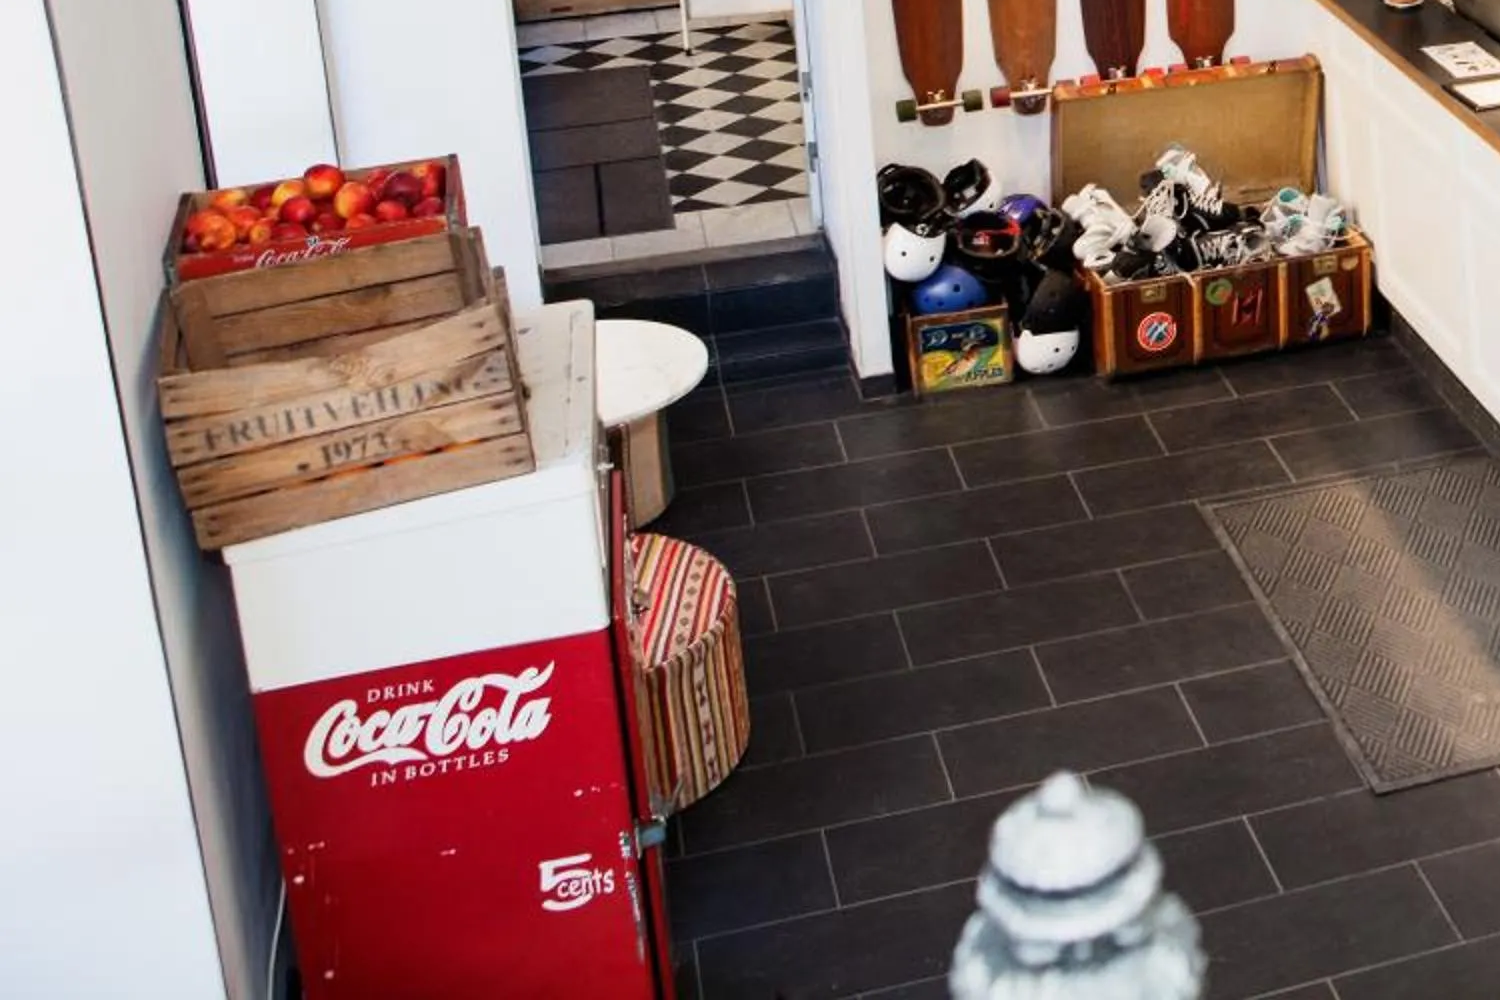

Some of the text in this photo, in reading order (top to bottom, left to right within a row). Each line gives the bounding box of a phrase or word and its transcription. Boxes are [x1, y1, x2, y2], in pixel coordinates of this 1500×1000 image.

[321, 430, 390, 469] 1973
[367, 679, 435, 703] DRINK
[370, 748, 509, 787] IN BOTTLES
[538, 853, 615, 911] 5 cents
